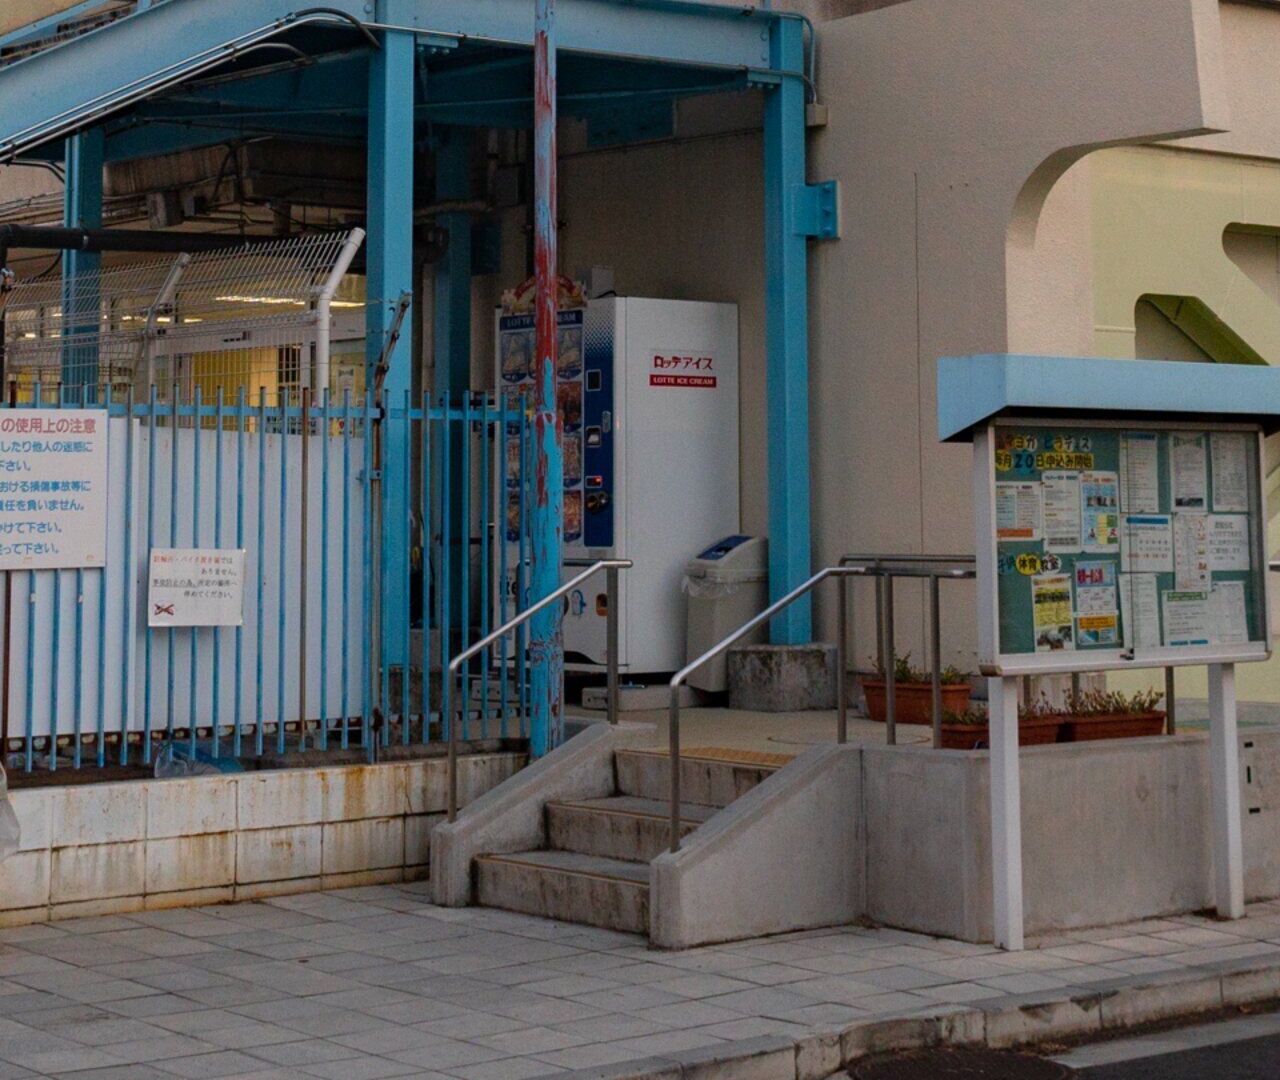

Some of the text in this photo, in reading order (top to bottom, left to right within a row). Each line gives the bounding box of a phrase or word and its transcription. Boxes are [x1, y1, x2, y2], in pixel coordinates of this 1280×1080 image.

[653, 355, 713, 370] ロッテアイス
[652, 377, 675, 385] LOTTE
[689, 378, 714, 386] CREAM
